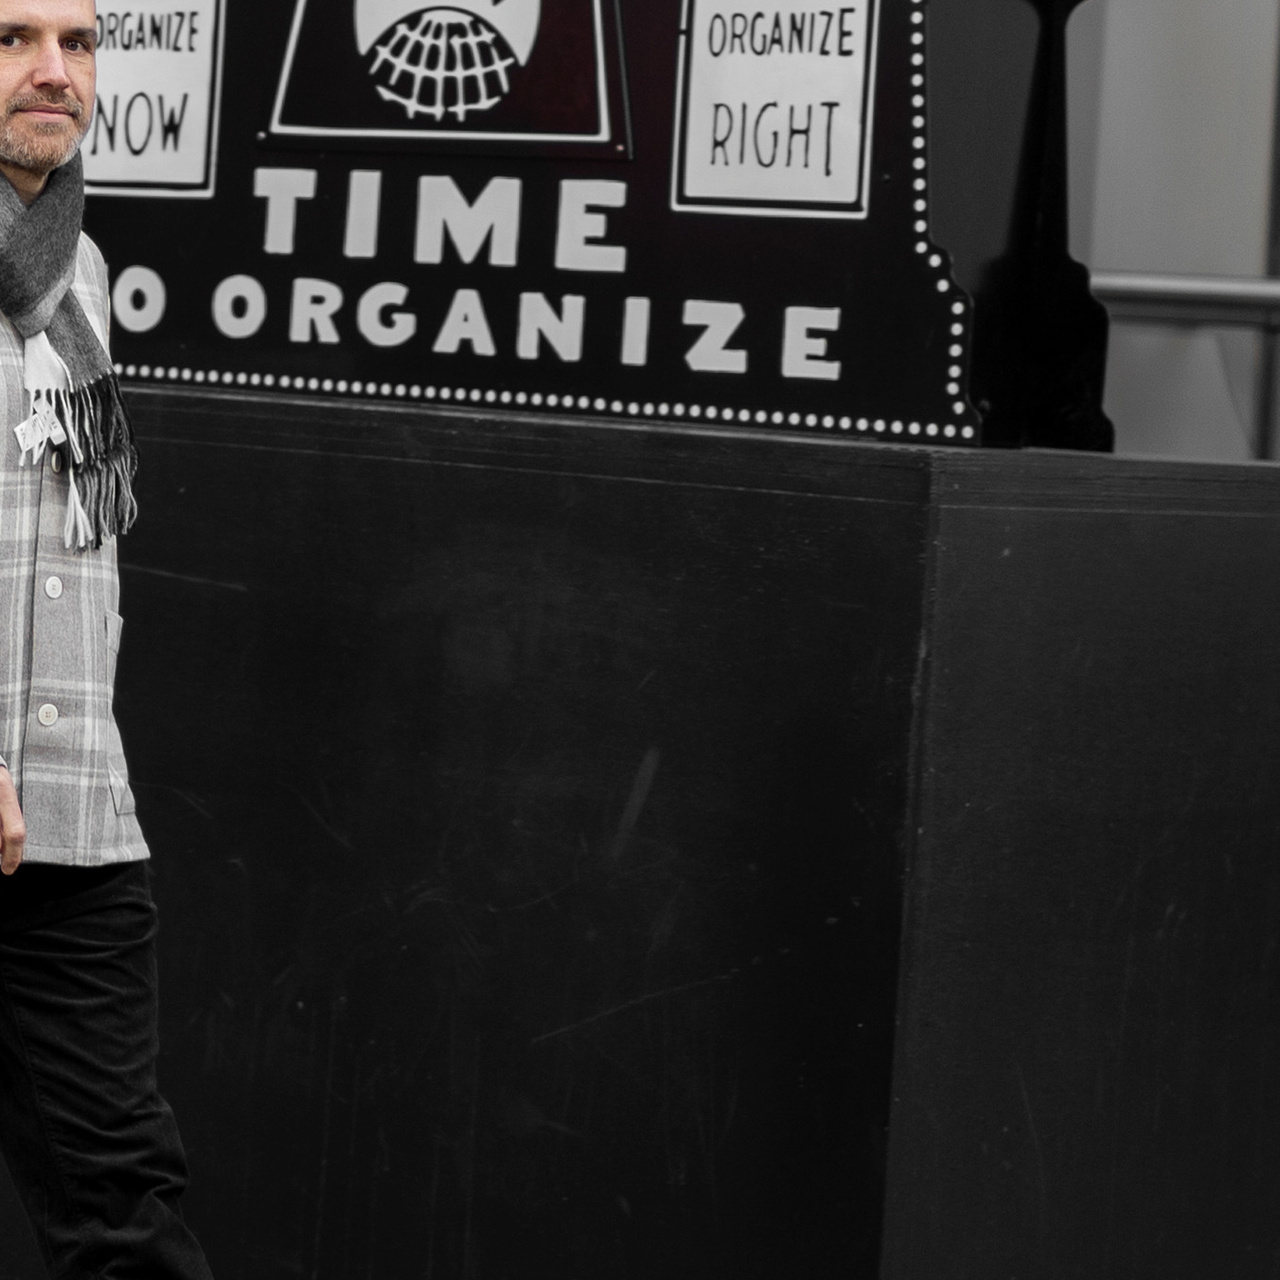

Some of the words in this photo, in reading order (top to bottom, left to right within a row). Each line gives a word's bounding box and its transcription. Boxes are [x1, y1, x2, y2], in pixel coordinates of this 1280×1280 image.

[709, 7, 856, 57] ORGANIZE
[90, 92, 189, 156] NOW
[710, 101, 841, 177] RIGHT
[253, 167, 627, 272] TIME
[112, 265, 166, 333] O
[211, 274, 842, 380] ORGANIZE
